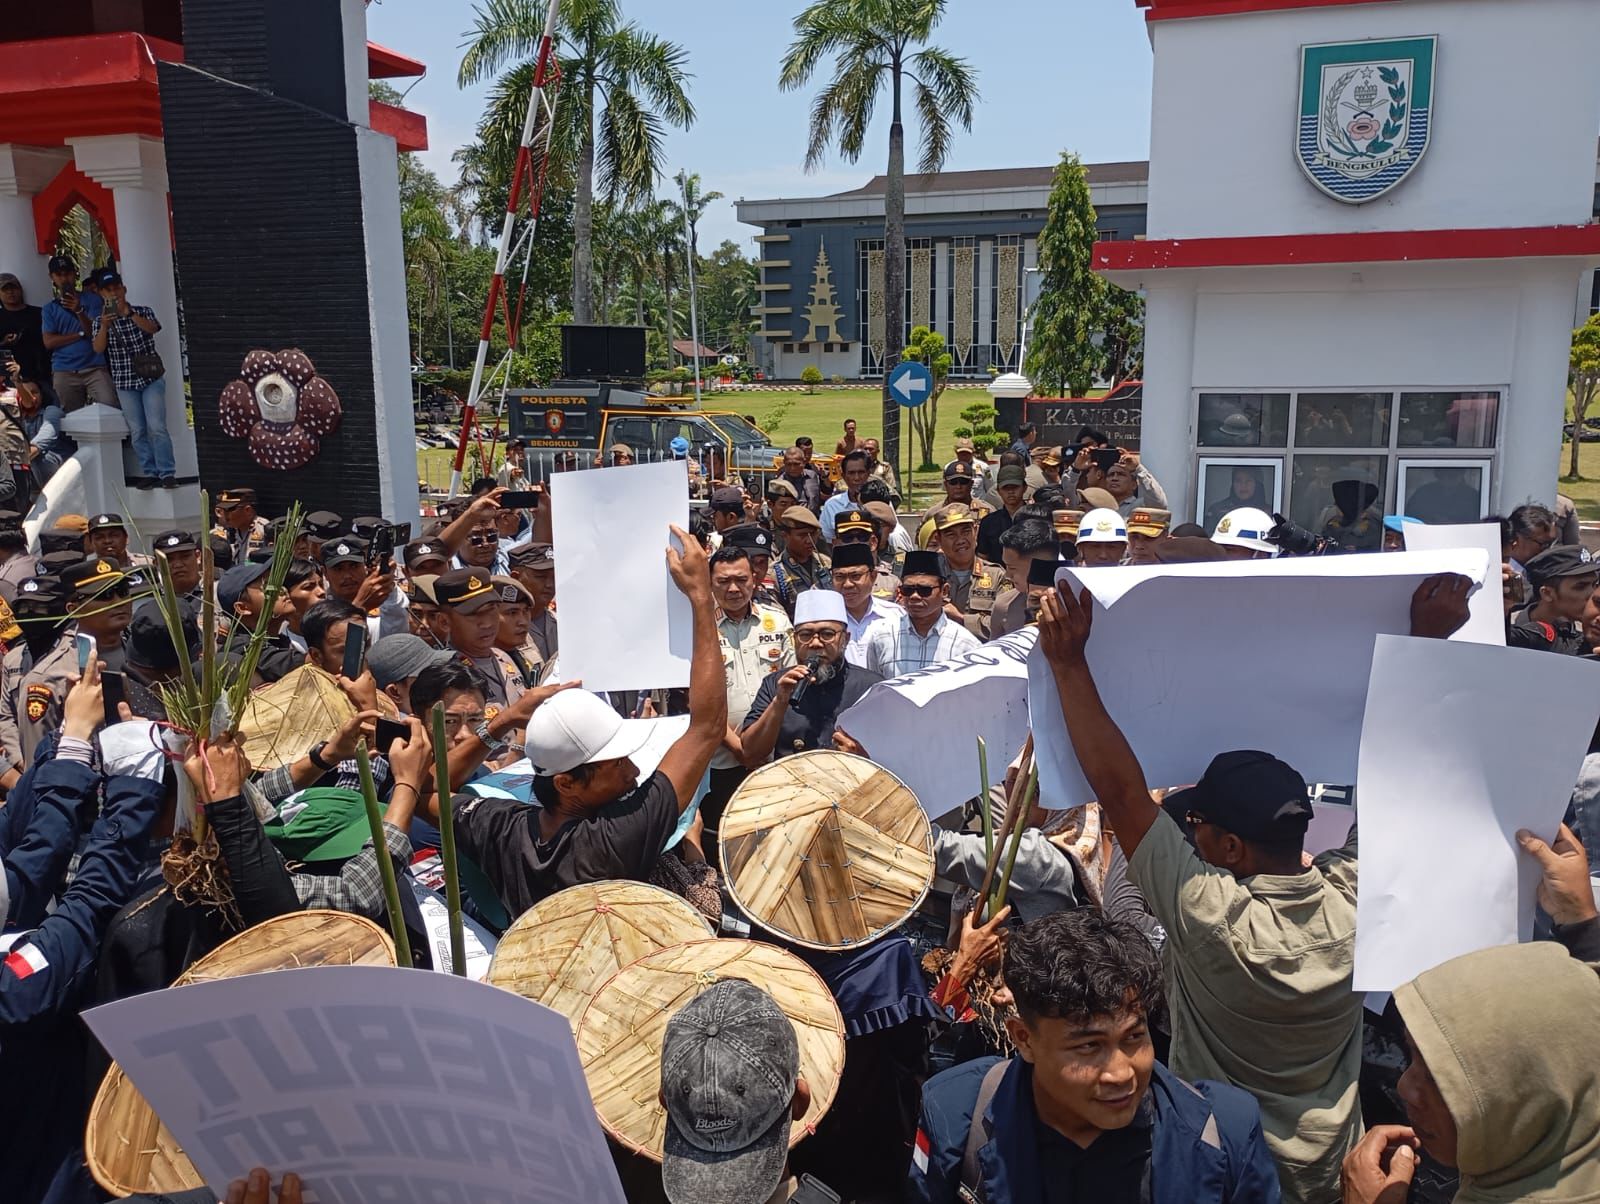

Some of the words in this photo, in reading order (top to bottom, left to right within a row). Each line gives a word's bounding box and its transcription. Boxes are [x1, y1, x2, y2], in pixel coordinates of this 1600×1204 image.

[1326, 156, 1397, 170] BENGKULU
[521, 396, 588, 404] POLRESTA
[530, 440, 579, 448] BENGKULU
[759, 635, 774, 643] POL
[695, 1117, 738, 1129] Bloods
